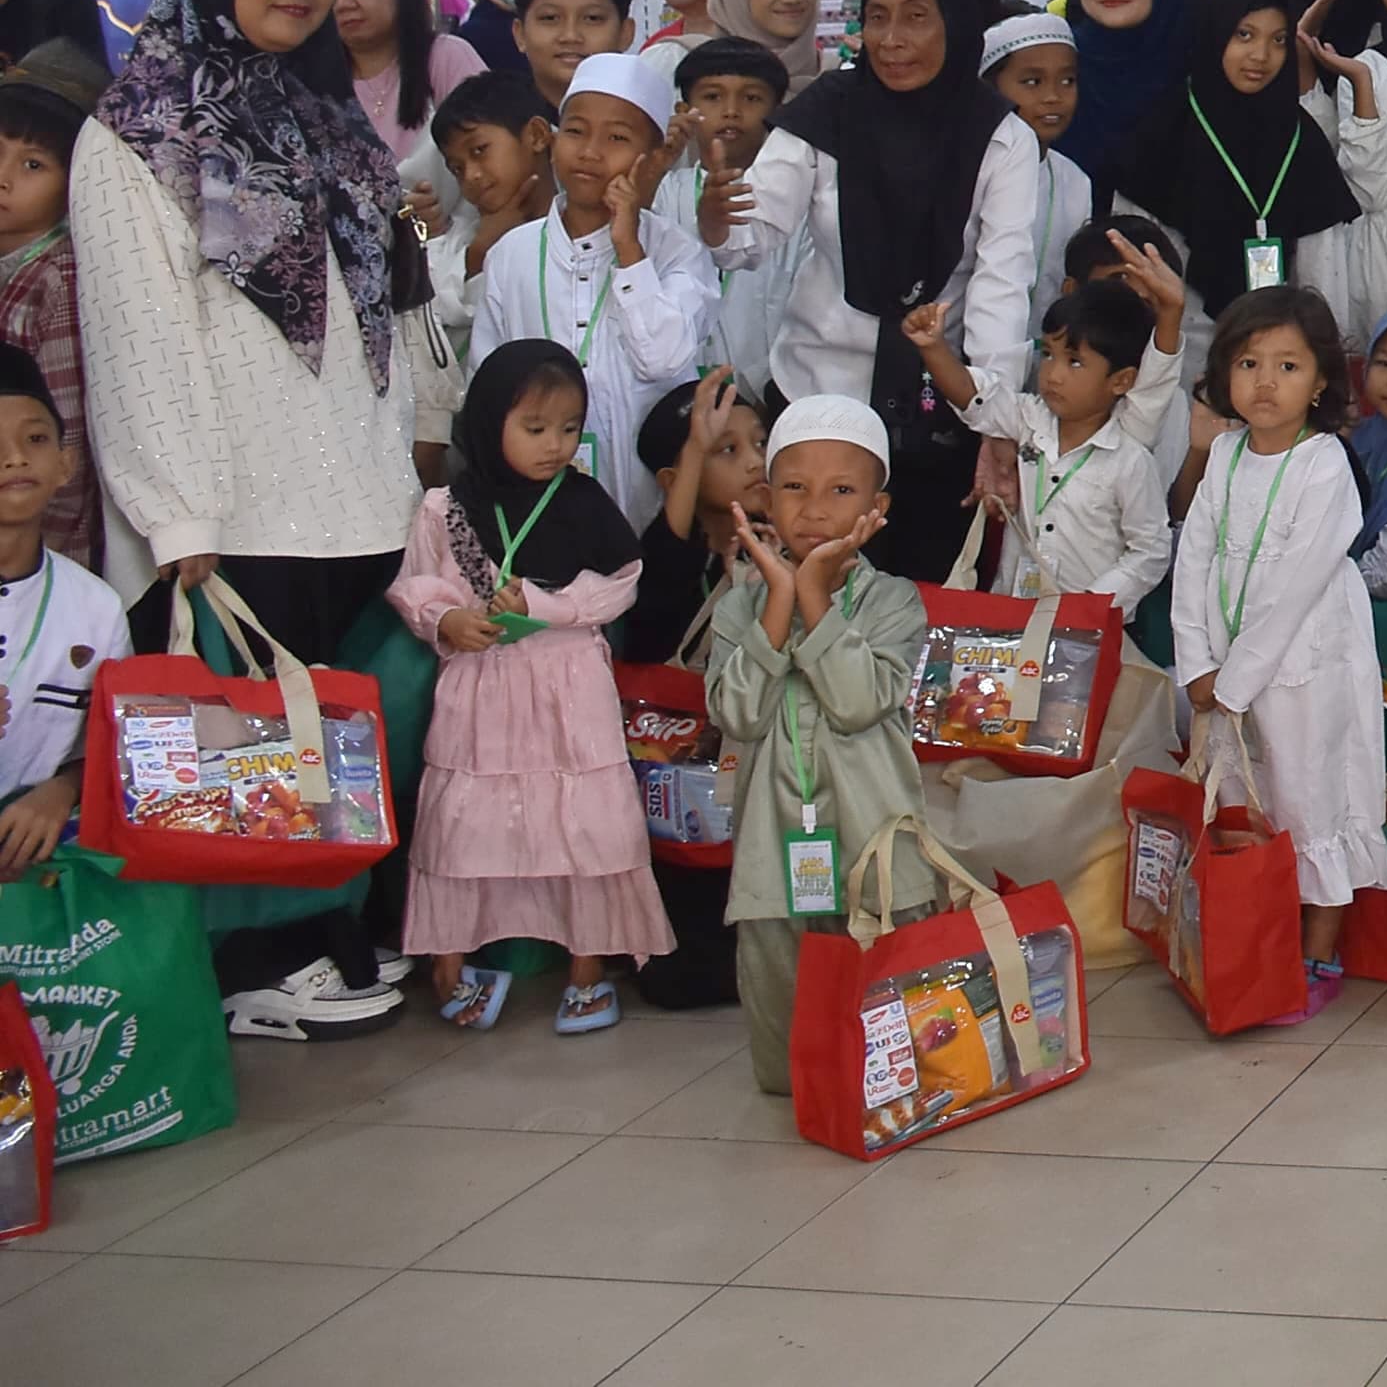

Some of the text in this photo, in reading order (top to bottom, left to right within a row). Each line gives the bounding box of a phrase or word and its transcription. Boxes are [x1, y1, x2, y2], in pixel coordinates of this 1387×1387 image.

[226, 750, 297, 781] CHIM
[649, 782, 663, 818] SOS
[1013, 1011, 1031, 1023] ABC
[117, 1014, 138, 1059] ANDA
